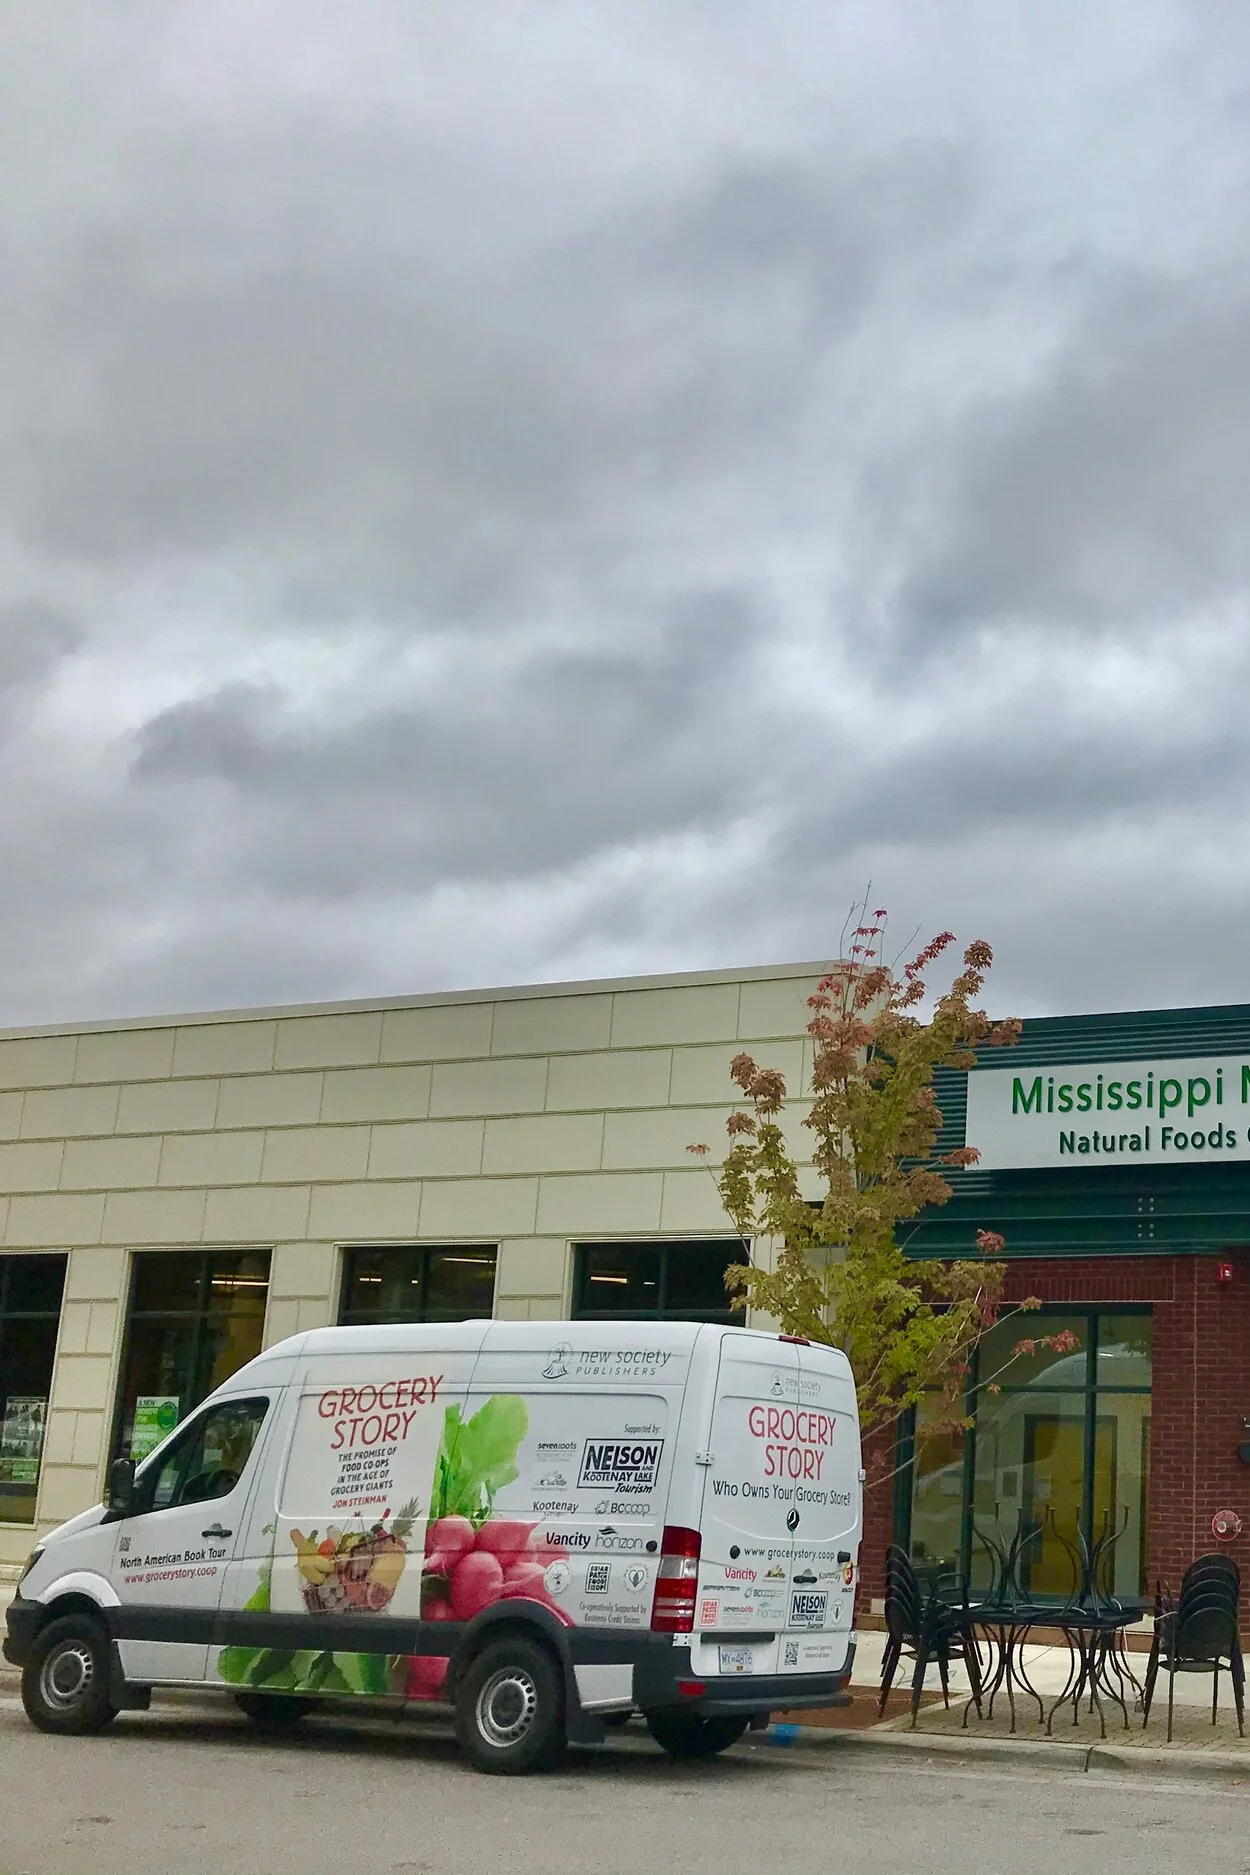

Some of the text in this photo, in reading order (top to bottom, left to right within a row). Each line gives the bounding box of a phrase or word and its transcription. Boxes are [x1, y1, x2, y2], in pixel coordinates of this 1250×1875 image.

[1011, 1067, 1225, 1118] Mississippi
[1058, 1125, 1150, 1155] Natural
[1161, 1122, 1236, 1151] Foods
[579, 1348, 672, 1368] new society
[576, 1366, 657, 1376] PUBLISHERS
[318, 1374, 444, 1418] GROCERY
[330, 1410, 417, 1449] STORY
[624, 1423, 652, 1435] Supported
[748, 1405, 837, 1446] GROCERY
[338, 1446, 398, 1462] THE PROMISE OF
[585, 1445, 658, 1471] NELSON
[764, 1444, 825, 1481] STORY
[341, 1461, 361, 1472] FOOD
[337, 1469, 390, 1484] IN THE AGE OF
[634, 1471, 653, 1482] LAKE
[330, 1480, 394, 1496] GROCERY GIANTS
[614, 1483, 653, 1494] Tourism
[713, 1480, 851, 1507] Who Owns Your Grocery Store?
[332, 1494, 388, 1509] JON STEINMAN
[532, 1500, 579, 1514] Kootenay
[546, 1531, 591, 1549] Vancity
[120, 1547, 226, 1568] North American Book Tour
[743, 1547, 835, 1563] www.grocerystory.coop
[124, 1566, 218, 1584] www.grocerystory.coop
[724, 1567, 757, 1583] Vancity
[792, 1595, 826, 1613] NELSON
